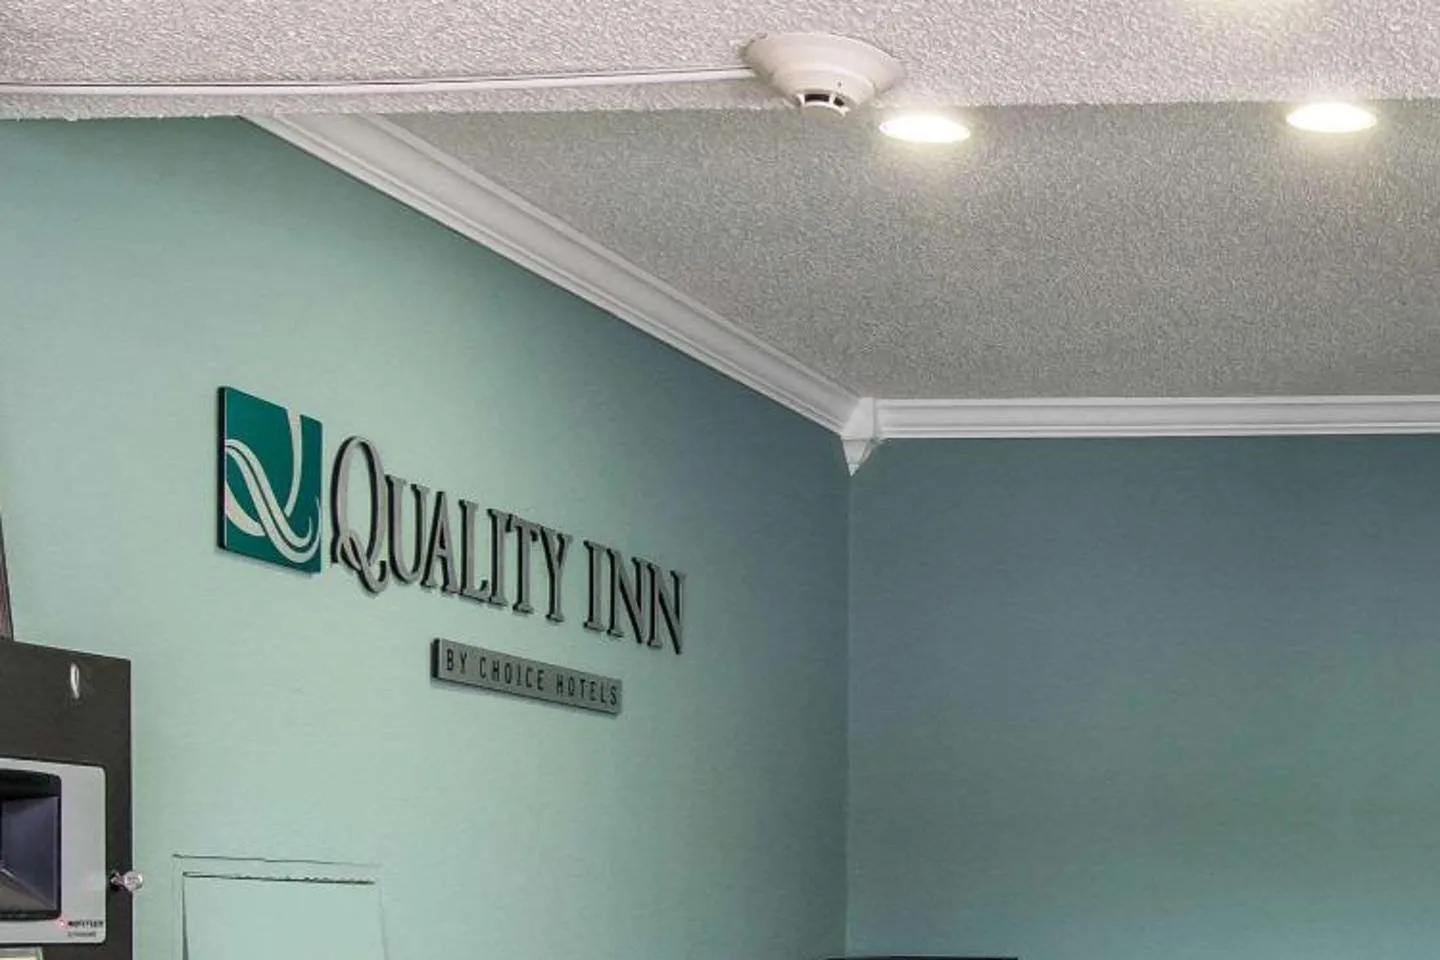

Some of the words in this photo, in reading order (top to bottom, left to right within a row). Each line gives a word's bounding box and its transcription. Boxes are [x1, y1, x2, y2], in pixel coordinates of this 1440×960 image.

[330, 435, 573, 622] QUALITY
[582, 539, 687, 655] INN
[446, 648, 468, 674] BY
[479, 656, 545, 691] CHOICE
[556, 673, 618, 706] HOTELS
